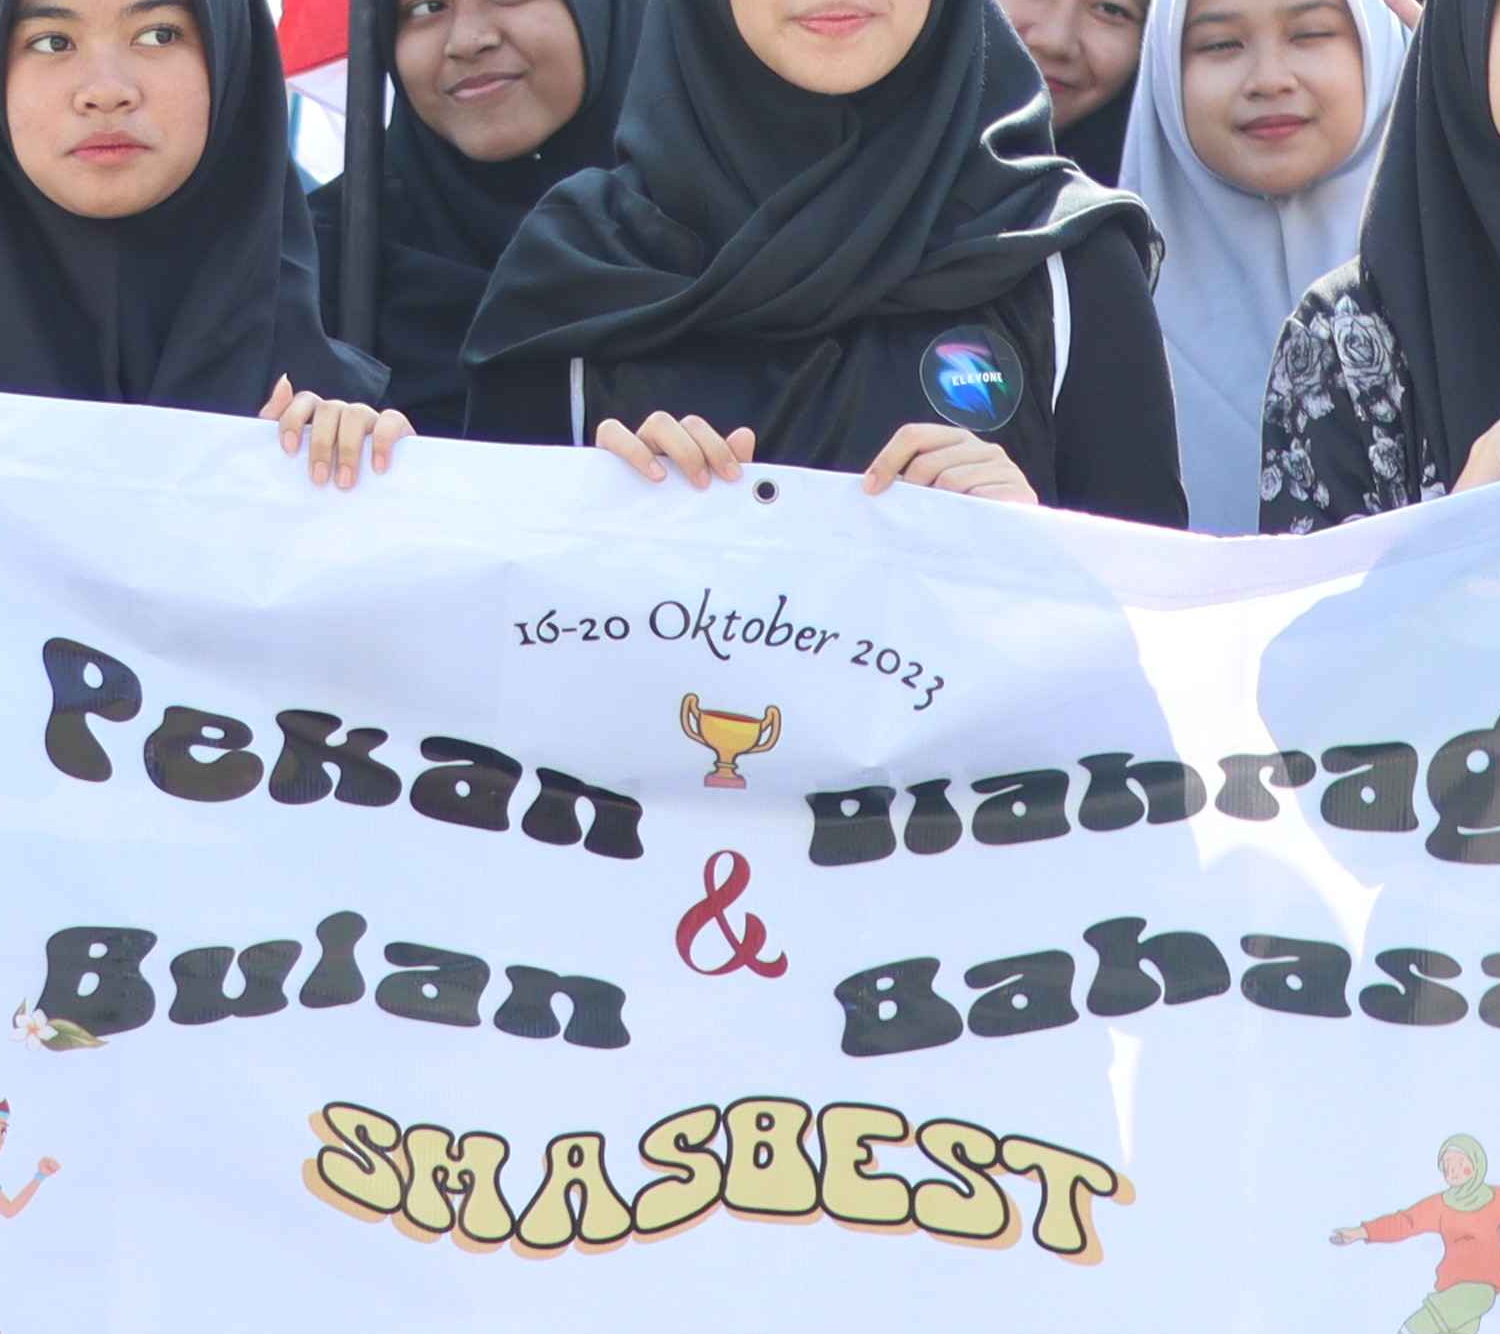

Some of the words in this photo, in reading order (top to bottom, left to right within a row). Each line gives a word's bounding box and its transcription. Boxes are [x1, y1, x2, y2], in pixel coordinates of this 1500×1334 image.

[514, 609, 631, 646] 16-20
[648, 587, 840, 661] Oktober
[850, 639, 945, 711] 2023
[42, 637, 644, 861] Pekan
[36, 911, 631, 1049] Bulan
[675, 850, 788, 979] &
[303, 1095, 1135, 1265] SMASBEST
